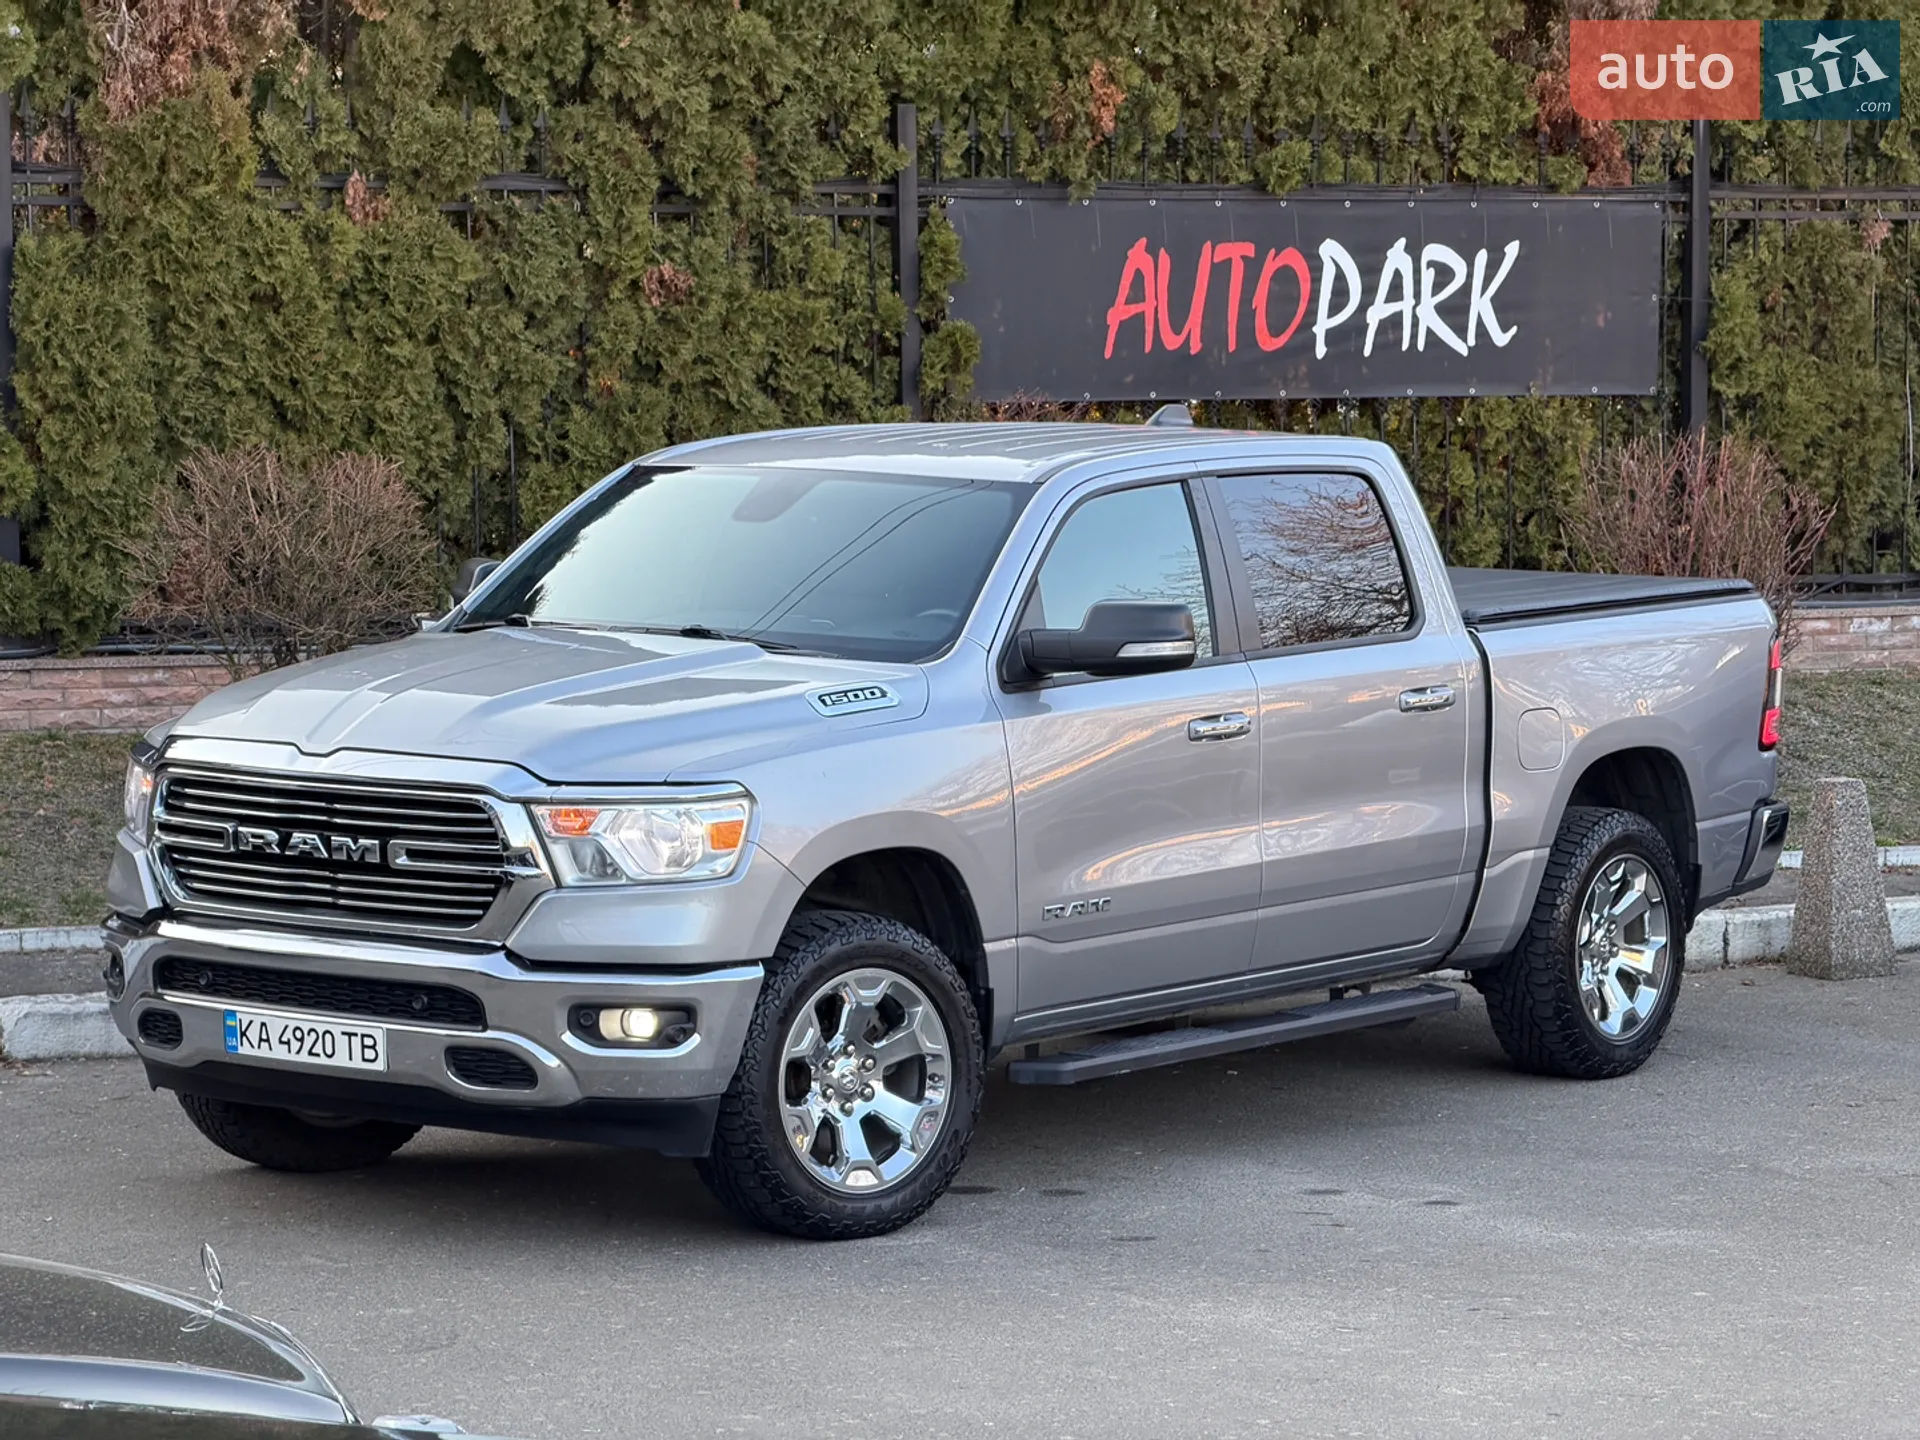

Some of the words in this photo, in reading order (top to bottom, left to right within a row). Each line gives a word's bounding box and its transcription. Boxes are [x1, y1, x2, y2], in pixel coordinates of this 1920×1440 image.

[1104, 237, 1520, 359] AUTOPARK
[820, 687, 882, 706] 1500
[237, 826, 380, 863] RAM
[1042, 897, 1111, 921] RAM
[226, 1036, 238, 1046] UA
[238, 1018, 273, 1051] KA
[278, 1024, 336, 1059] 4920
[341, 1031, 379, 1063] TB
